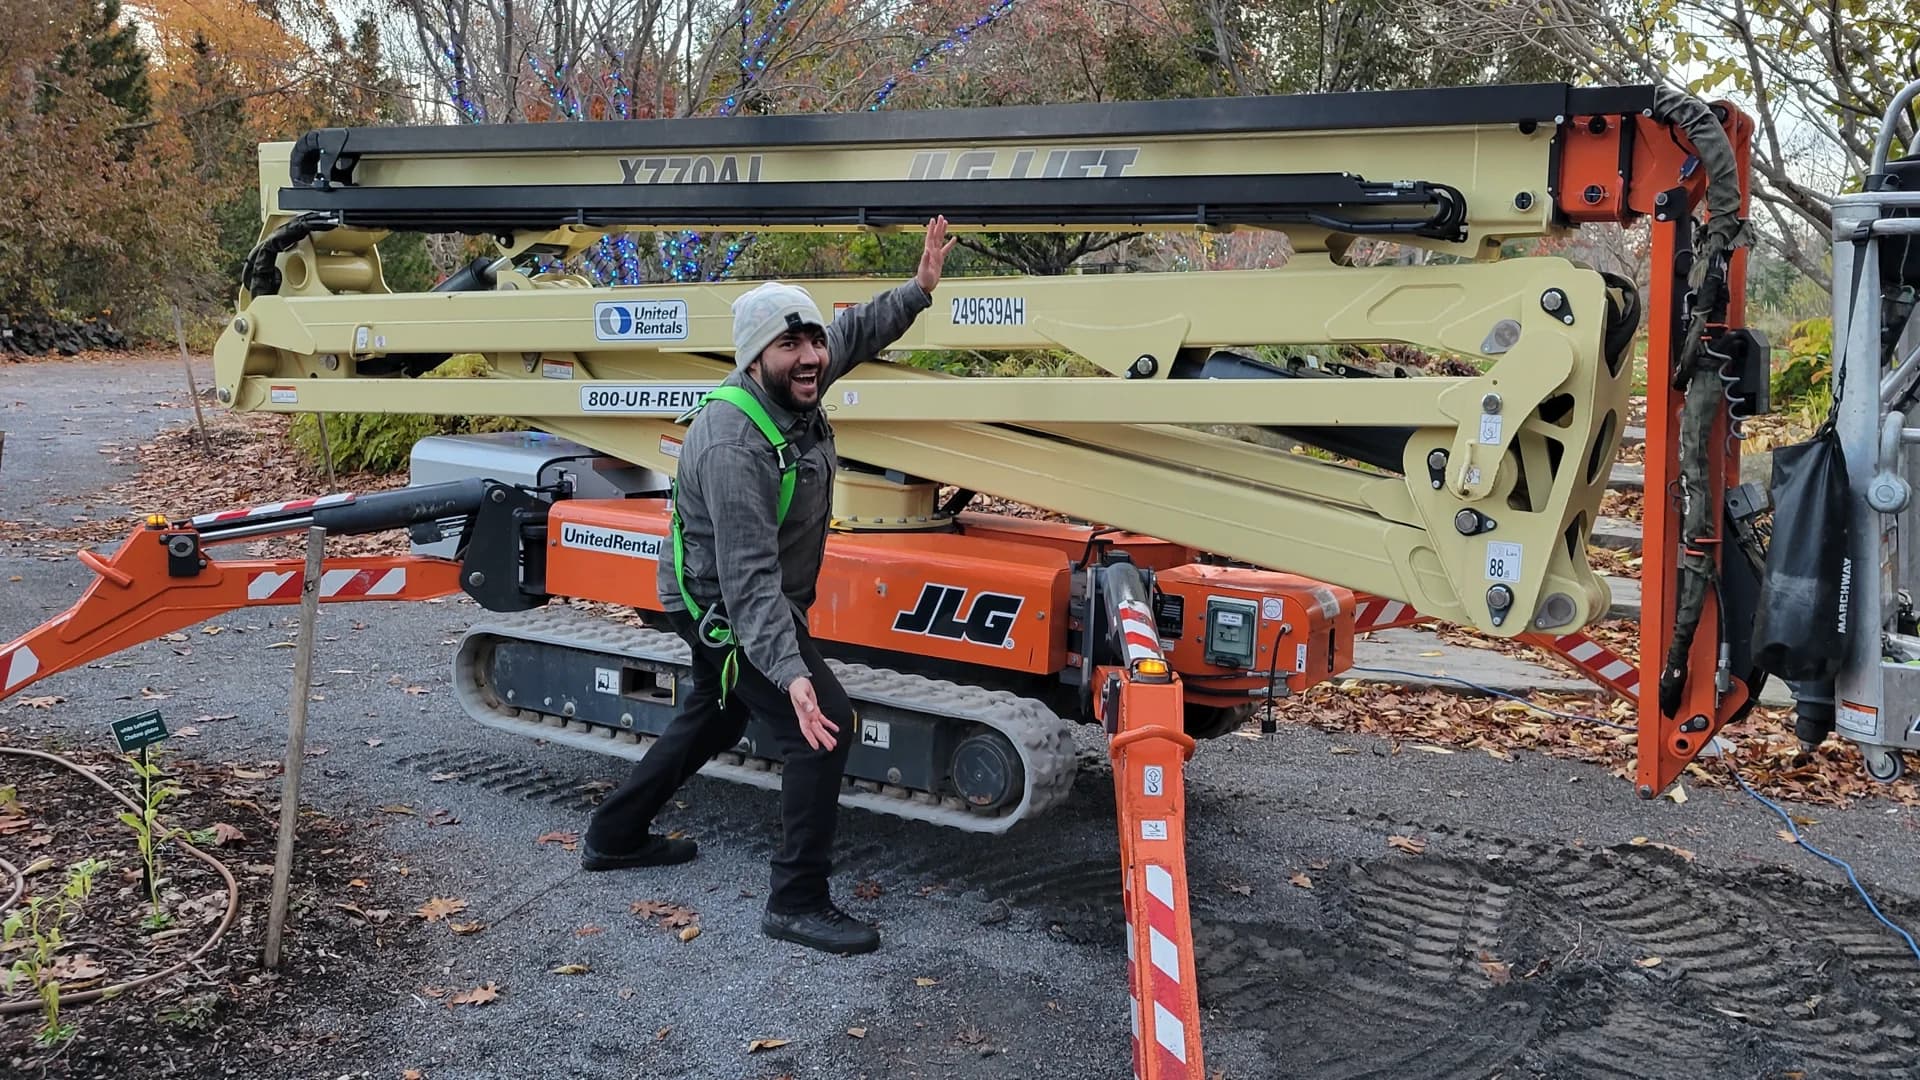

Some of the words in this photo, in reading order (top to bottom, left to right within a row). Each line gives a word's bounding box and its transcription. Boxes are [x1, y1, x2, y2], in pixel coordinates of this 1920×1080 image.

[634, 306, 678, 320] United
[952, 297, 1023, 325] 249639AH
[634, 321, 683, 335] Rentals
[588, 391, 710, 407] 800-UR-RENT
[564, 527, 660, 555] UnitedRental
[1489, 558, 1504, 577] 88
[1837, 557, 1852, 634] MARCHWAY
[892, 582, 1025, 648] JLG
